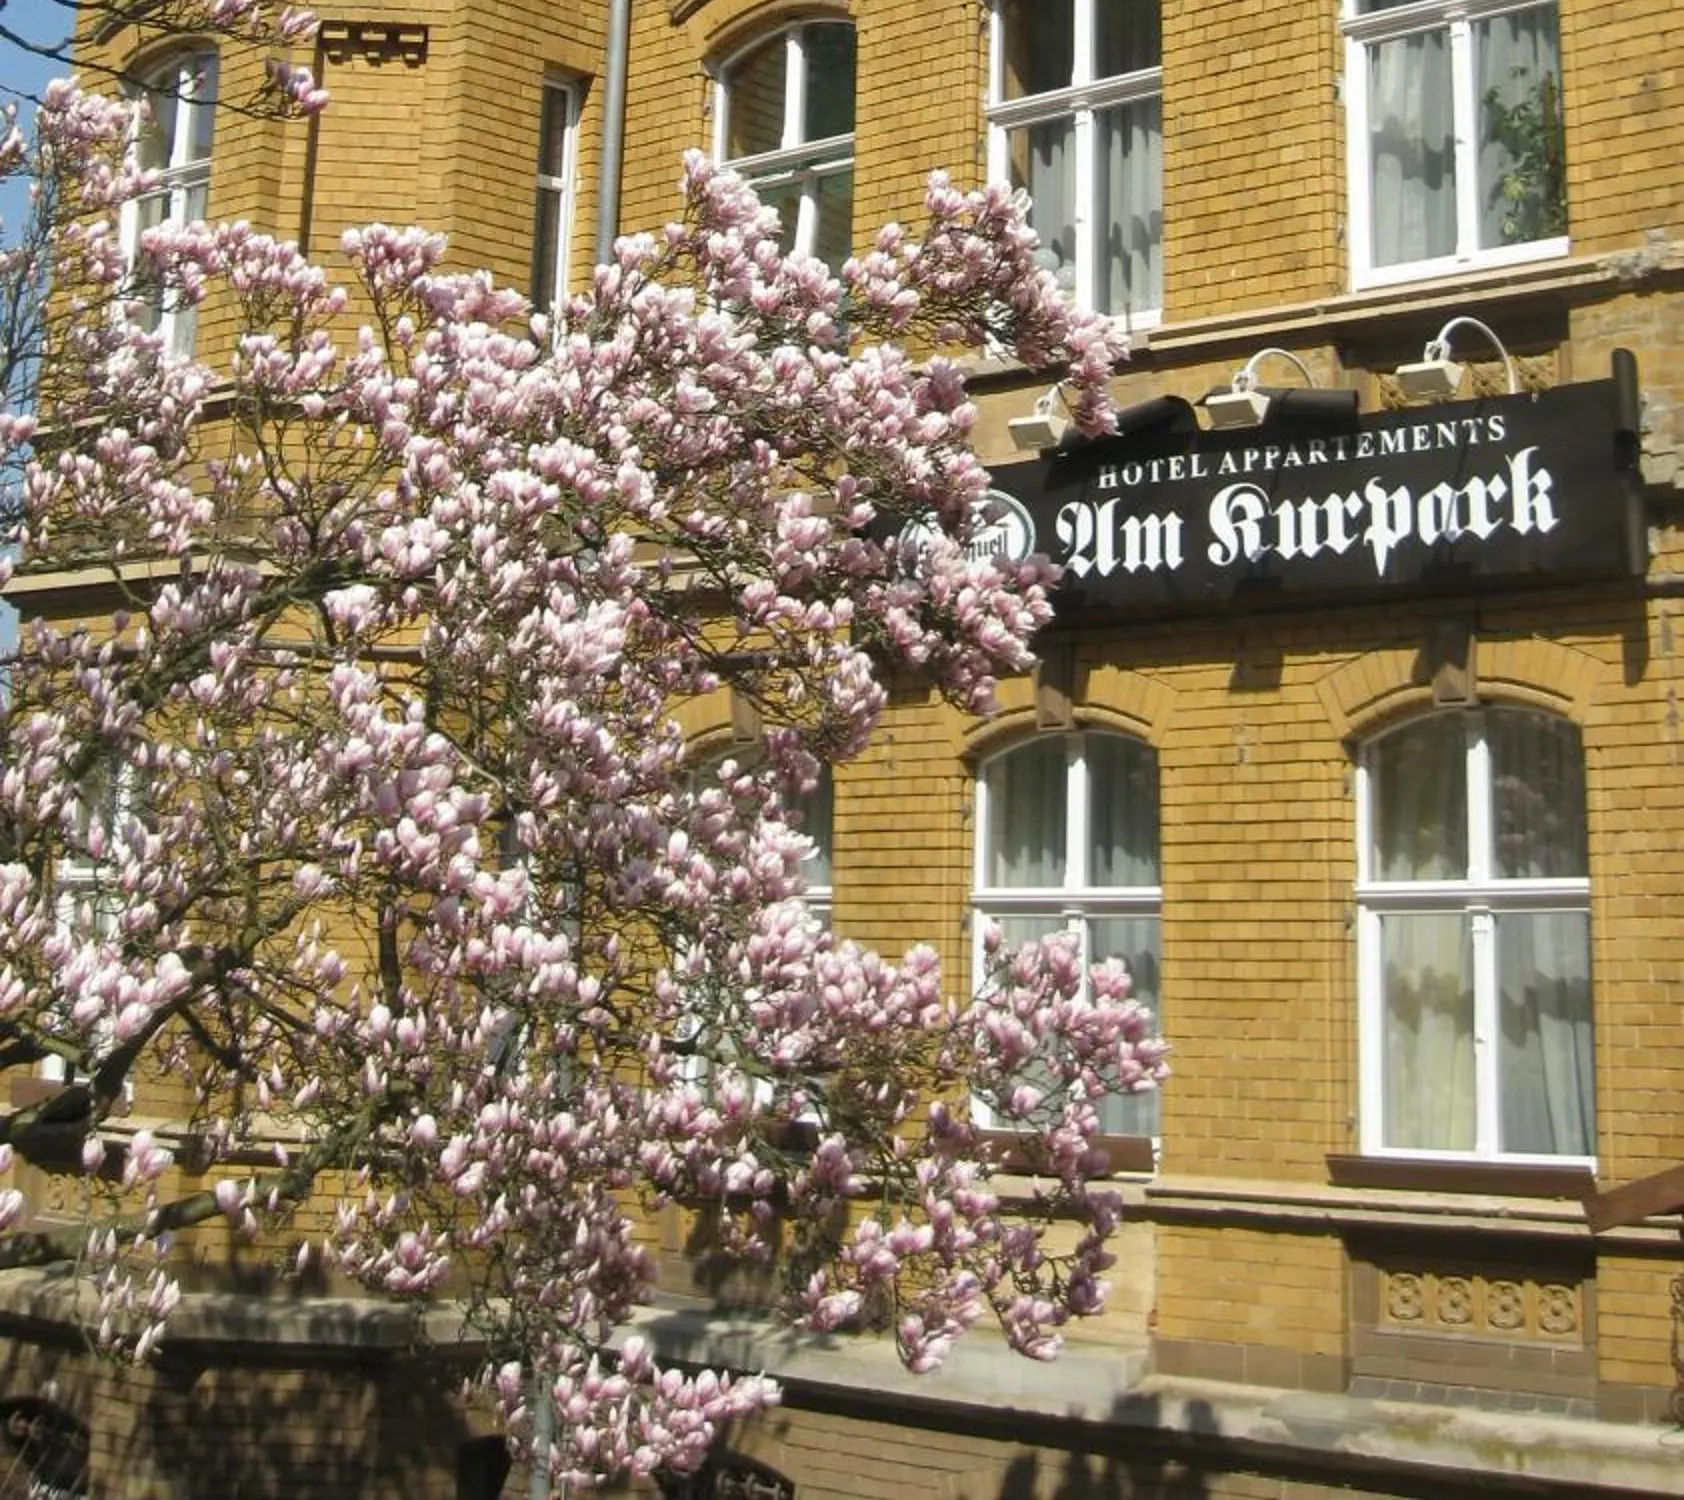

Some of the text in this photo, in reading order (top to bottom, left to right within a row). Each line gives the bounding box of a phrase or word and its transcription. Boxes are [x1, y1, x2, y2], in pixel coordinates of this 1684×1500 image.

[1097, 414, 1507, 489] HOTEL APPARTEMENTS
[1055, 445, 1560, 578] Am Kurpark
